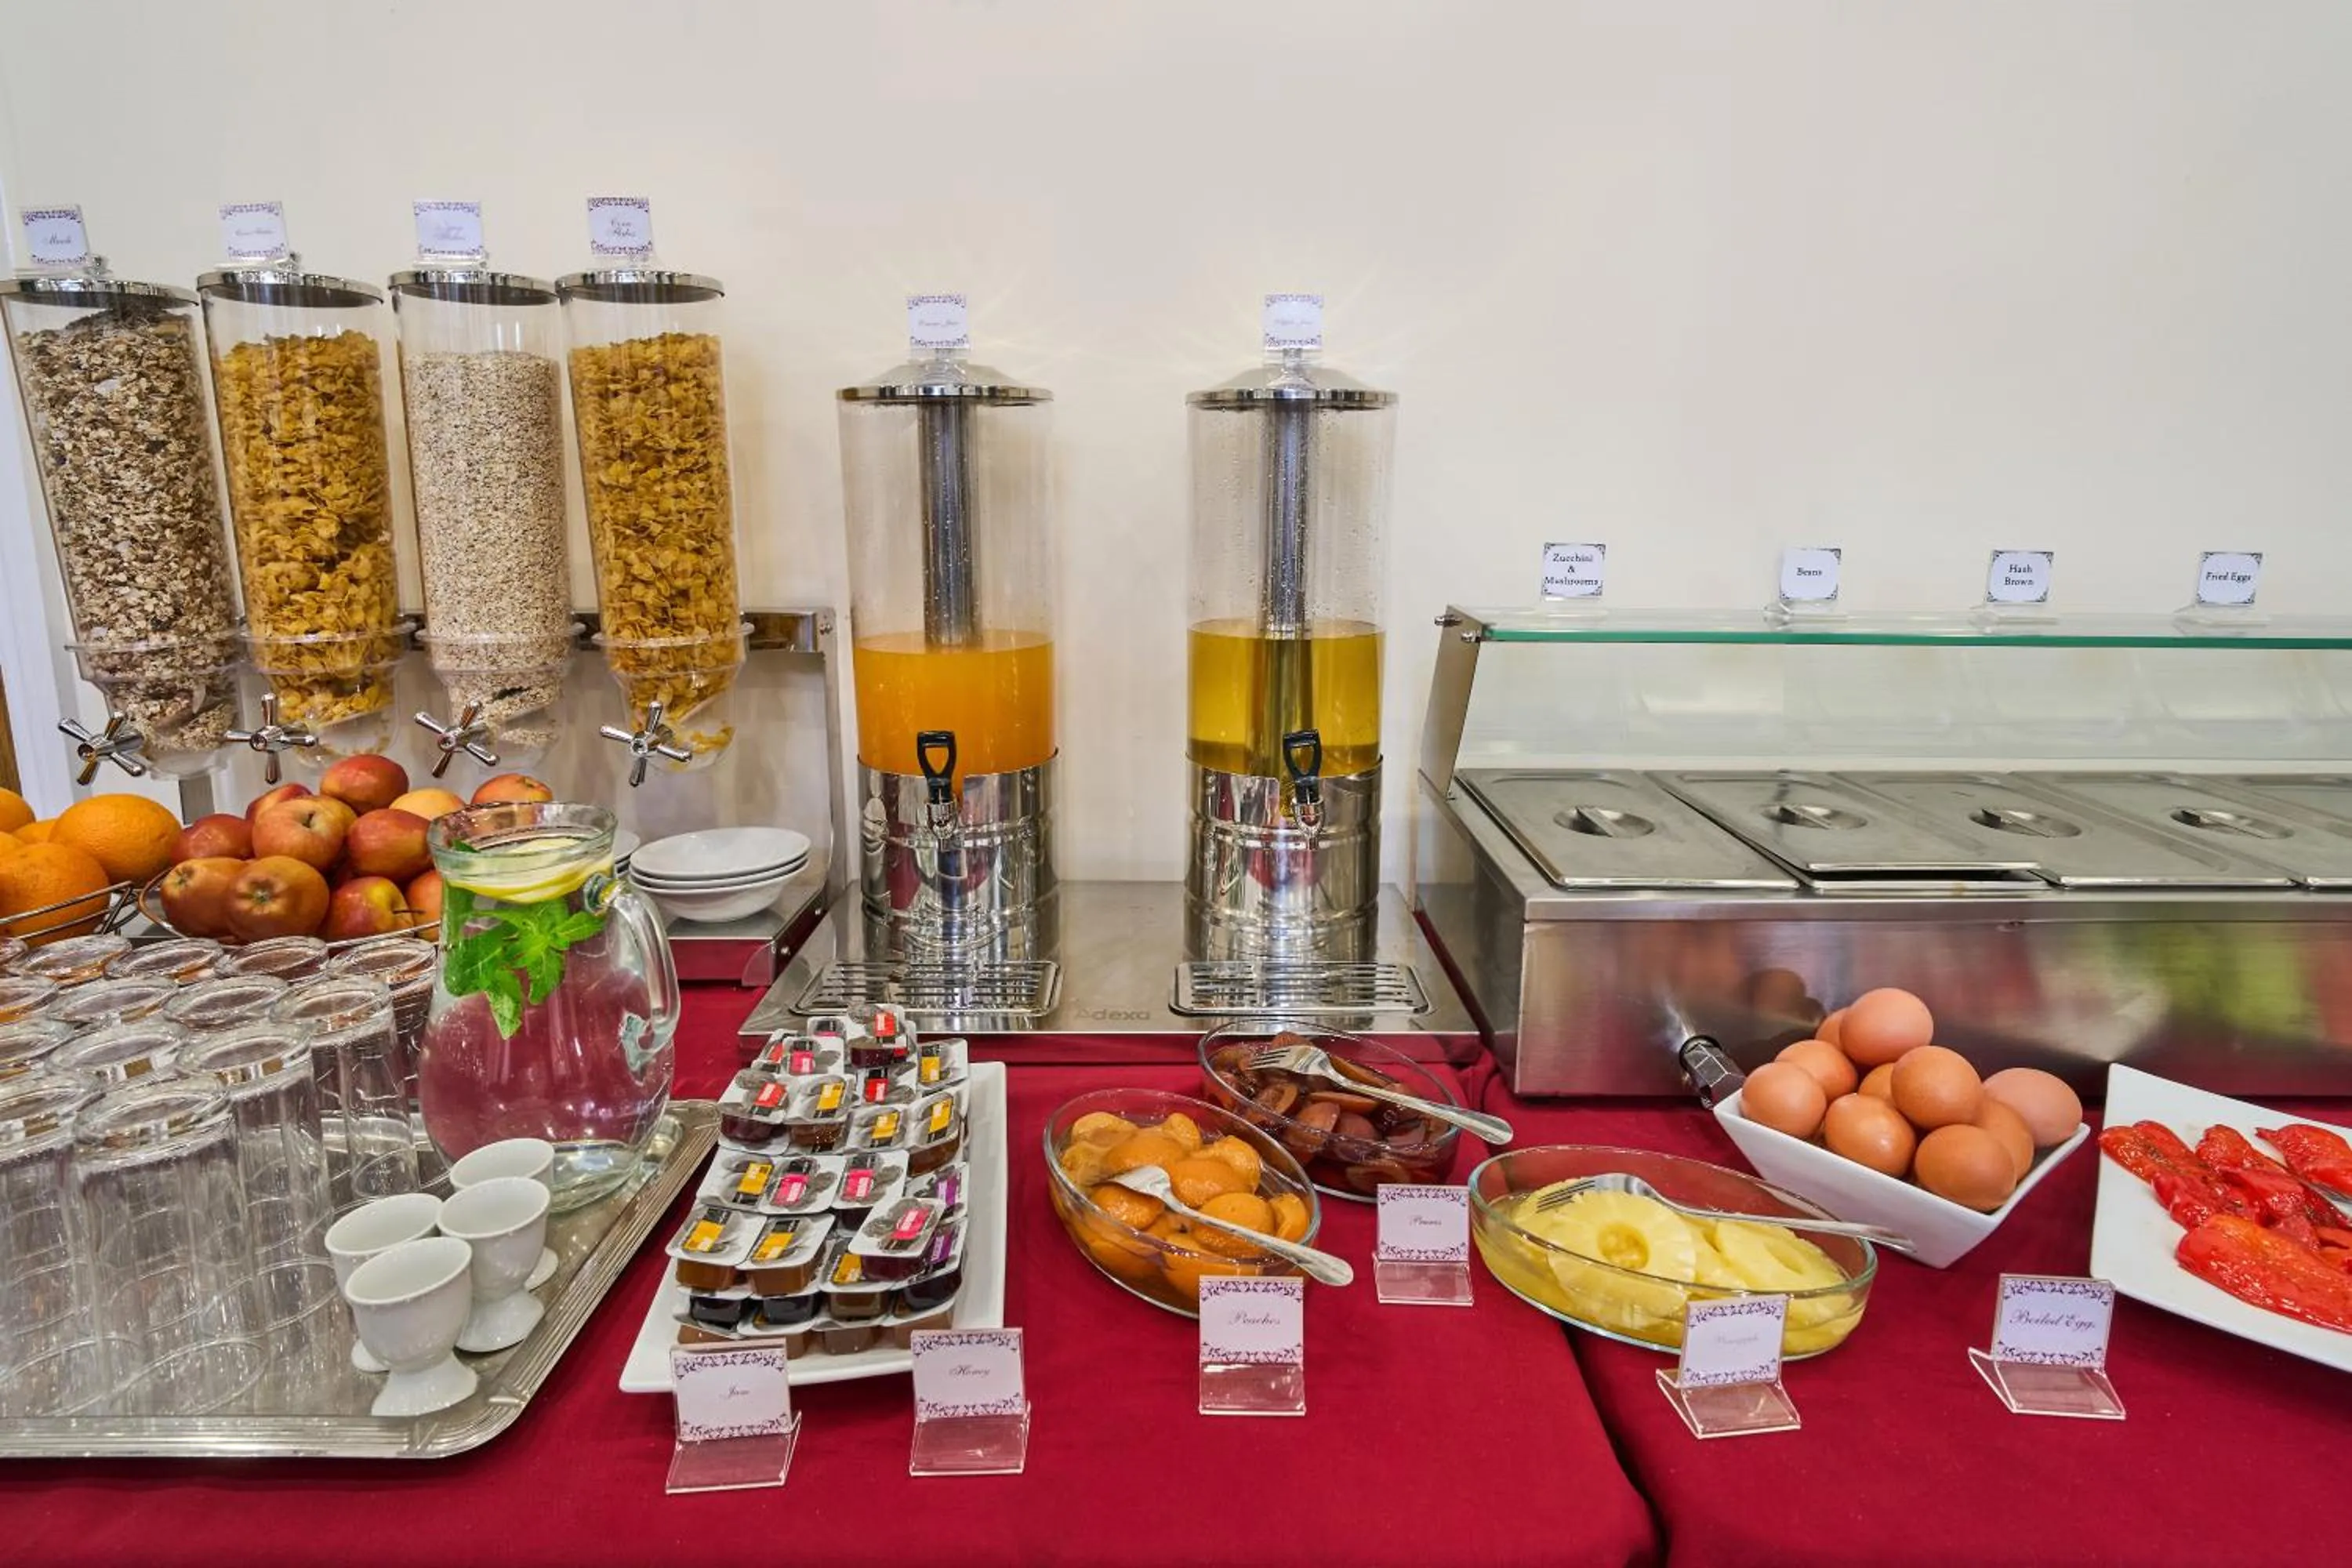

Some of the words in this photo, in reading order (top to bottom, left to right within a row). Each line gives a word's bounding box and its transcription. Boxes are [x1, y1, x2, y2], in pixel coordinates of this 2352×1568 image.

[1552, 551, 1594, 562] Zucchini
[1796, 567, 1823, 576] Beans
[2009, 564, 2033, 573] Hash
[1544, 575, 1599, 586] Mushrooms
[2004, 576, 2034, 586] Brown
[2205, 572, 2229, 581] Fried
[2230, 572, 2251, 584] Eggs
[1075, 1008, 1150, 1021] Adexa
[1228, 1308, 1281, 1326] Peaches
[949, 1364, 990, 1380] Honey
